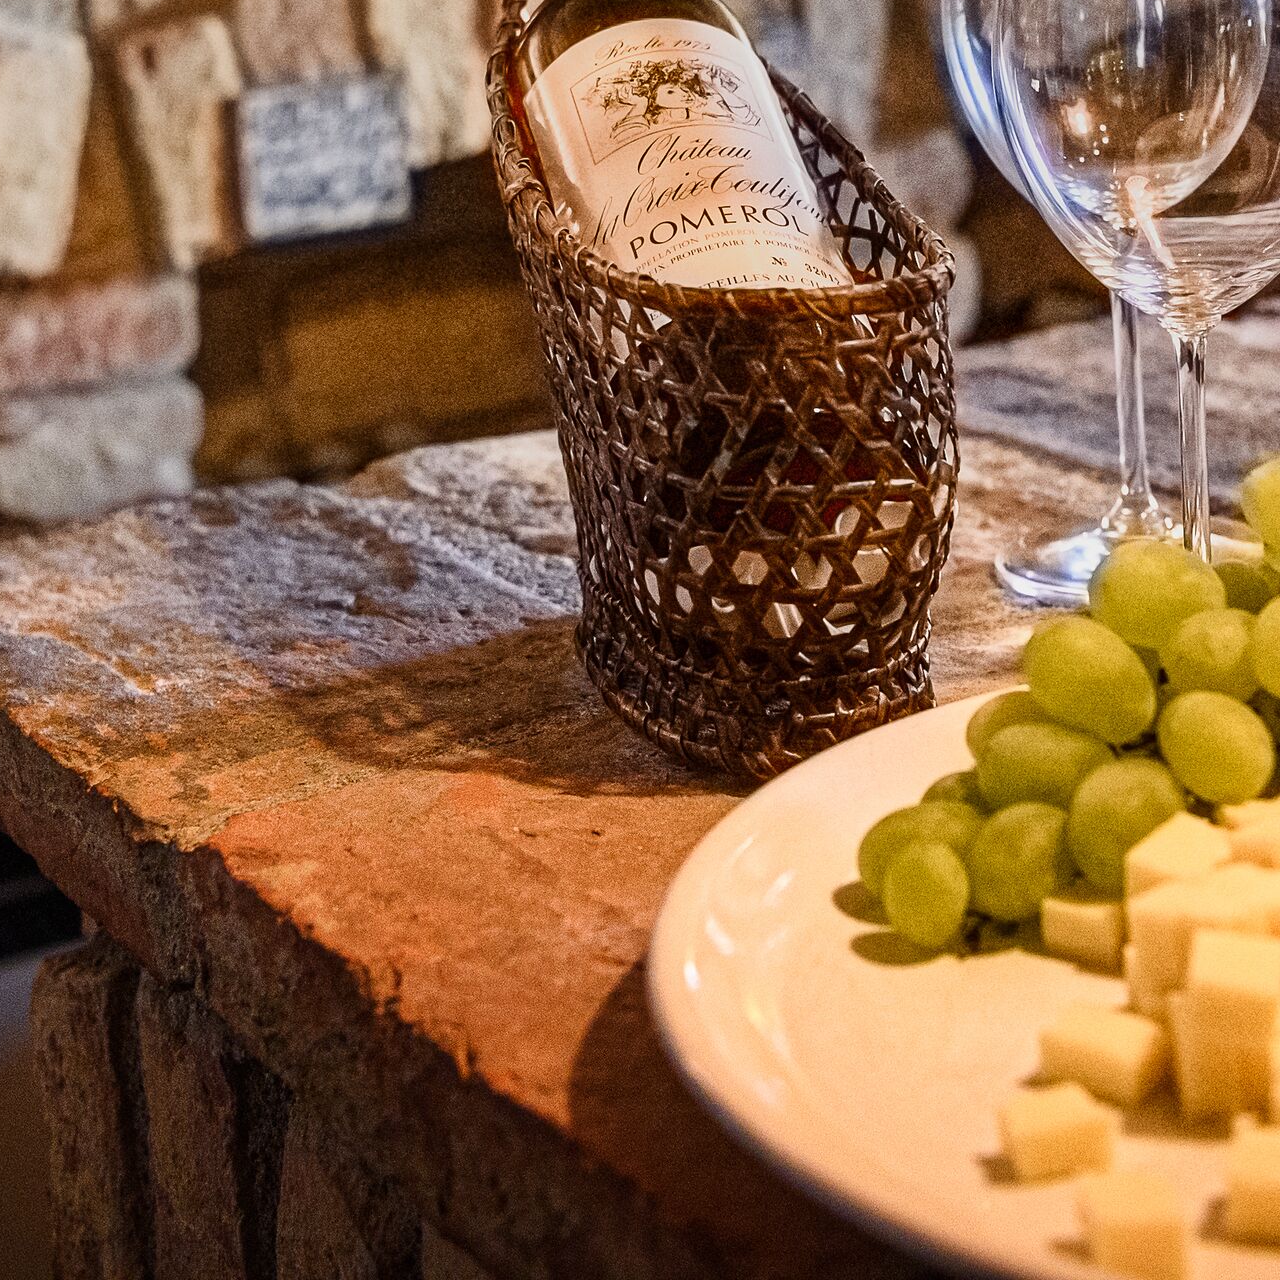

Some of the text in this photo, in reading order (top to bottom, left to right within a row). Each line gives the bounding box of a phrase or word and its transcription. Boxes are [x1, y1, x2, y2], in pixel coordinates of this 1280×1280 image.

[637, 133, 754, 176] Château
[629, 204, 809, 260] POMEROL
[635, 238, 699, 273] PPELLATION
